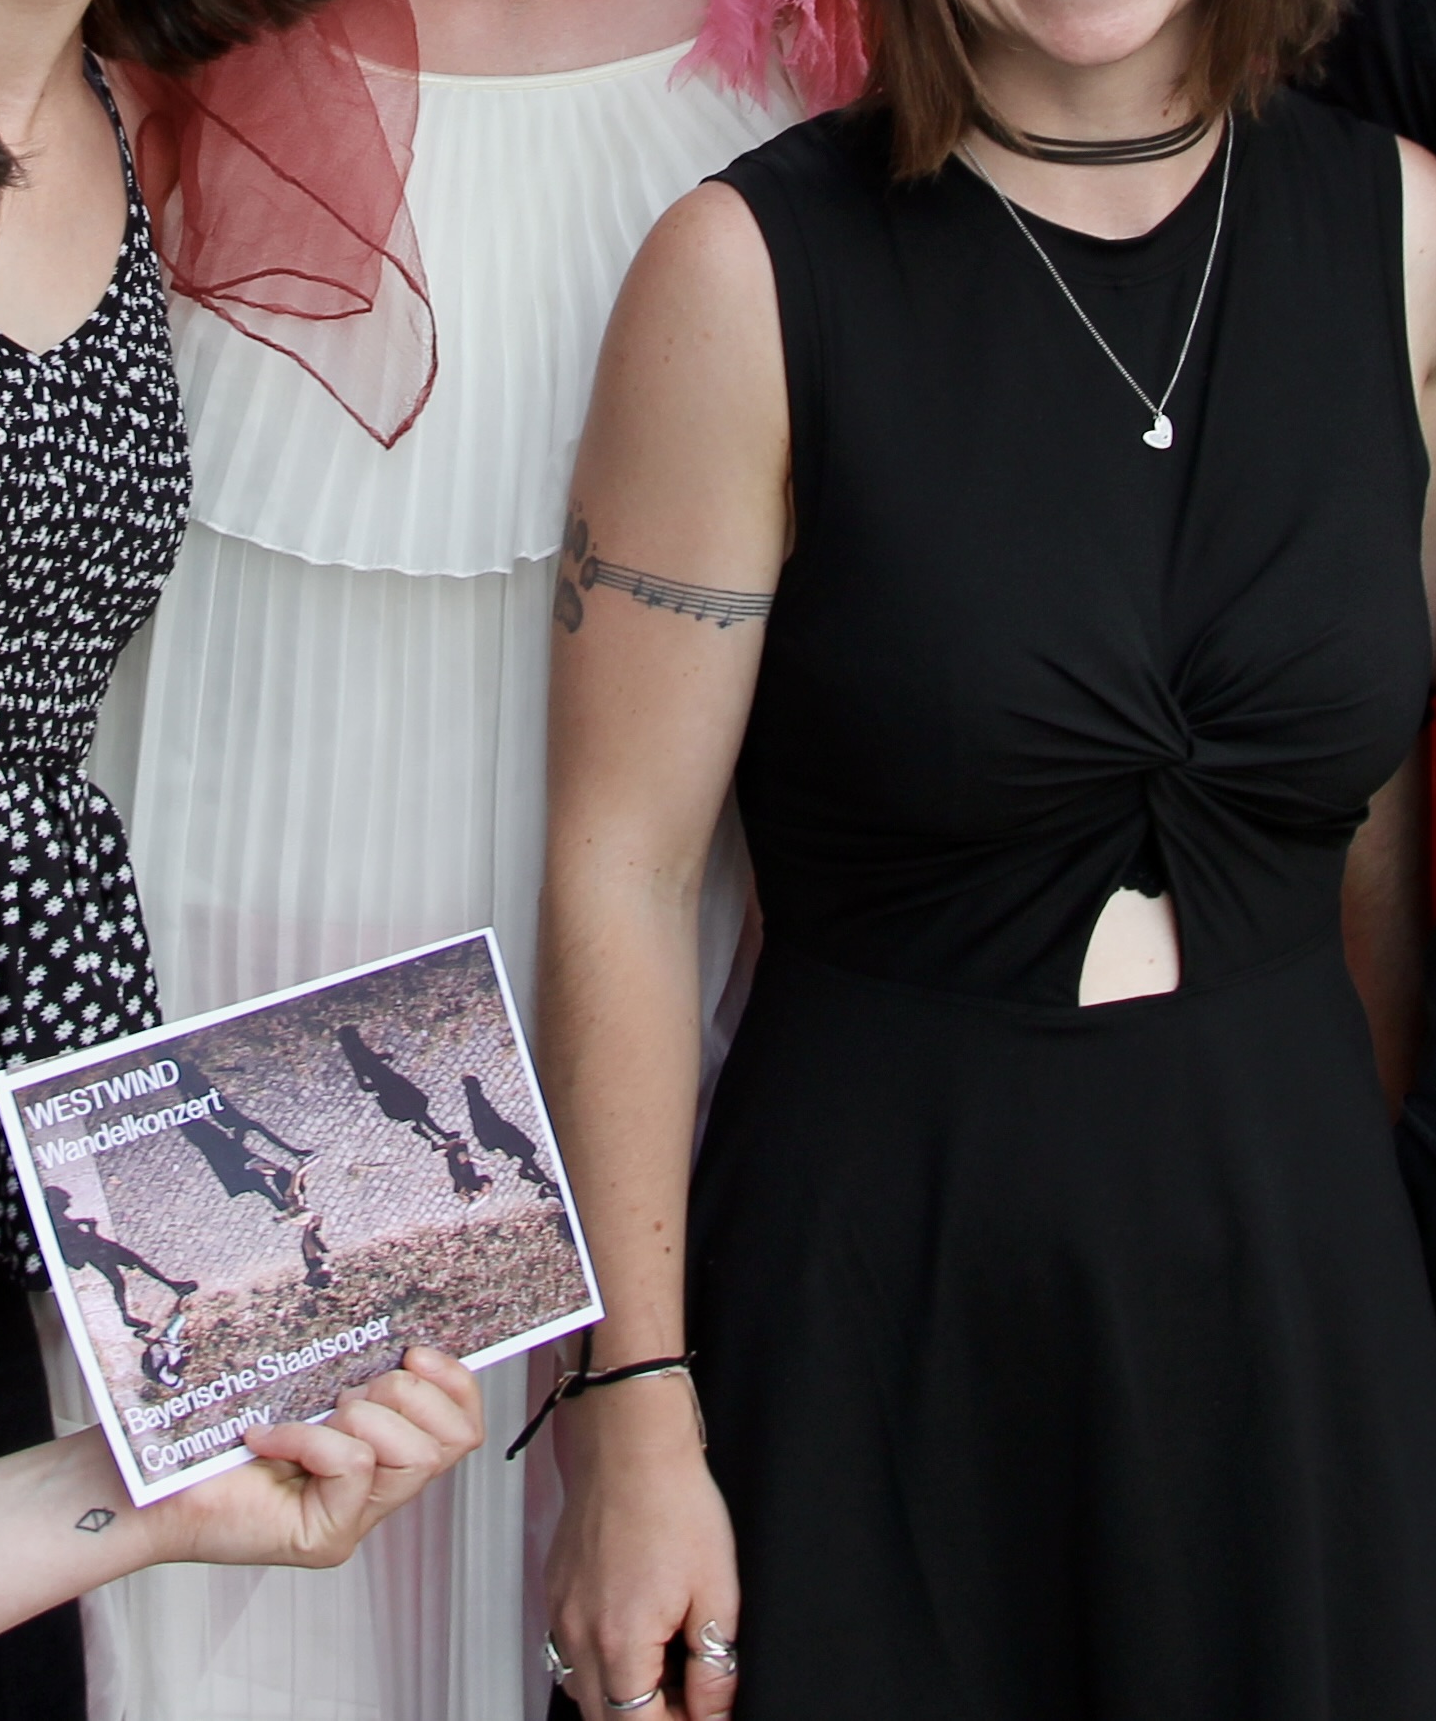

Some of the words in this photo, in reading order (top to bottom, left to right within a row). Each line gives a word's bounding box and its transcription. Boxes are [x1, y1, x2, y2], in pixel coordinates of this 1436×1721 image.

[24, 1060, 180, 1130] WESTWIND
[36, 1088, 224, 1169] Wandelkonzert
[124, 1367, 257, 1435] Bayerische
[256, 1314, 391, 1381] Staatsoper
[141, 1405, 270, 1472] Community
